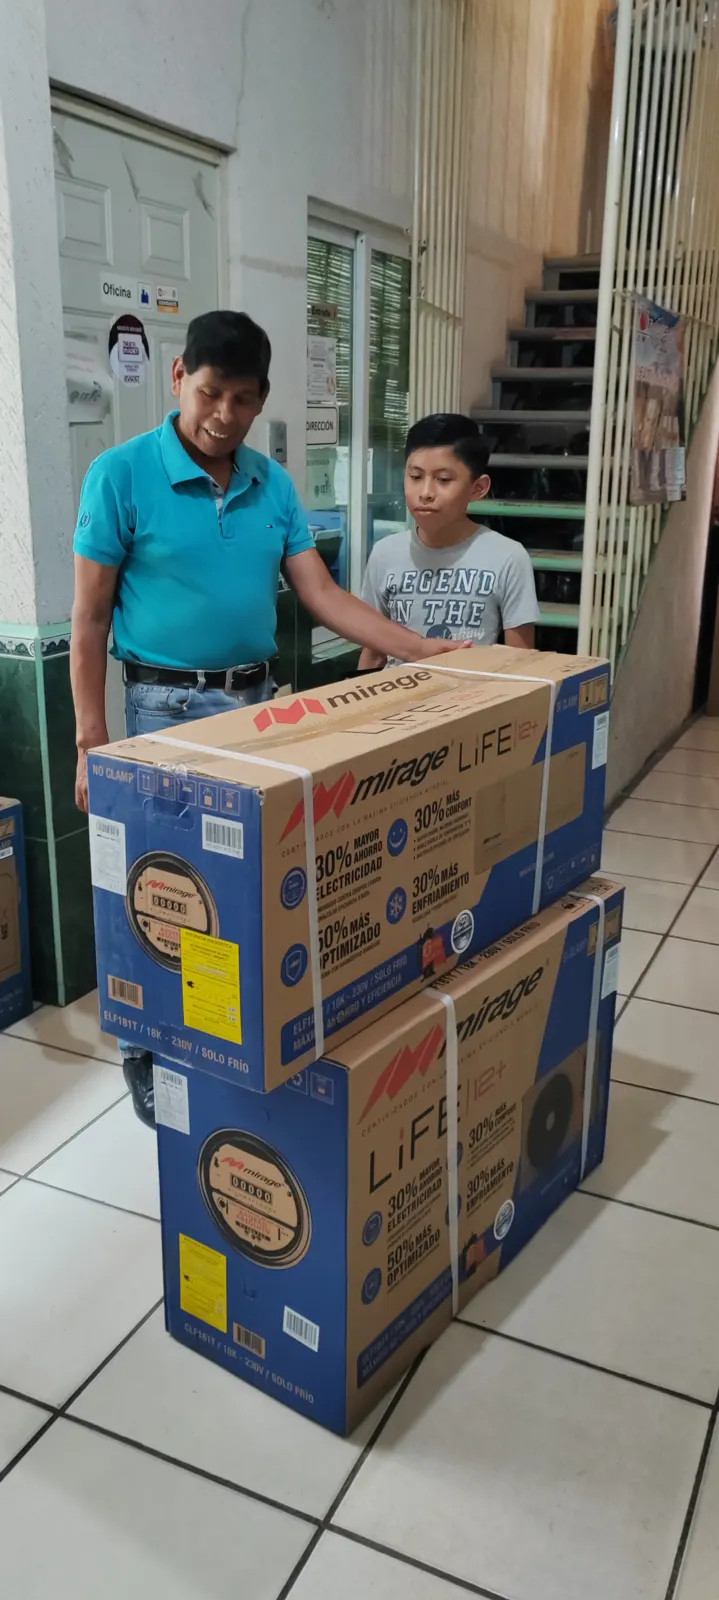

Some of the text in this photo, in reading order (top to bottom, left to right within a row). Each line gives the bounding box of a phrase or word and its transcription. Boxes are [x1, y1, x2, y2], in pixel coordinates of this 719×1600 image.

[103, 282, 132, 299] Oficina
[306, 420, 334, 431] DIRECCIÓN
[385, 568, 497, 596] LEGEND
[423, 599, 486, 627] THE
[326, 669, 433, 708] mirage
[92, 764, 134, 784] NO CLAMP
[350, 744, 450, 806] mirage
[414, 790, 460, 833] 30% MÁS
[445, 797, 472, 818] CONFORT
[353, 828, 380, 850] MAYOR
[353, 840, 383, 865] AHORRO
[163, 886, 196, 899] mirage
[412, 863, 458, 899] 30% MÁS
[412, 872, 470, 915] ENFRIAMIENTO
[154, 896, 186, 914] 00000
[350, 912, 370, 932] MÁS
[374, 966, 392, 983] SOLO
[437, 966, 544, 1060] mirage
[104, 1010, 137, 1031] ELF181T
[146, 1027, 162, 1040] 18K
[171, 1035, 192, 1052] 230V
[201, 1047, 225, 1065] SOLO
[228, 1057, 249, 1074] FRÍO
[469, 1112, 494, 1150] 30%
[232, 1176, 271, 1204] 00000
[243, 1166, 282, 1190] mirage
[467, 1165, 491, 1200] 30%
[387, 1178, 442, 1233] ELECTRICIDAD
[388, 1176, 418, 1219] 30%
[387, 1234, 414, 1273] 50%
[415, 1224, 432, 1245] MÁS
[387, 1228, 441, 1287] OPTIMIZADO
[223, 1344, 238, 1361] 18K
[244, 1357, 264, 1376] 230V
[271, 1373, 293, 1393] SOLO
